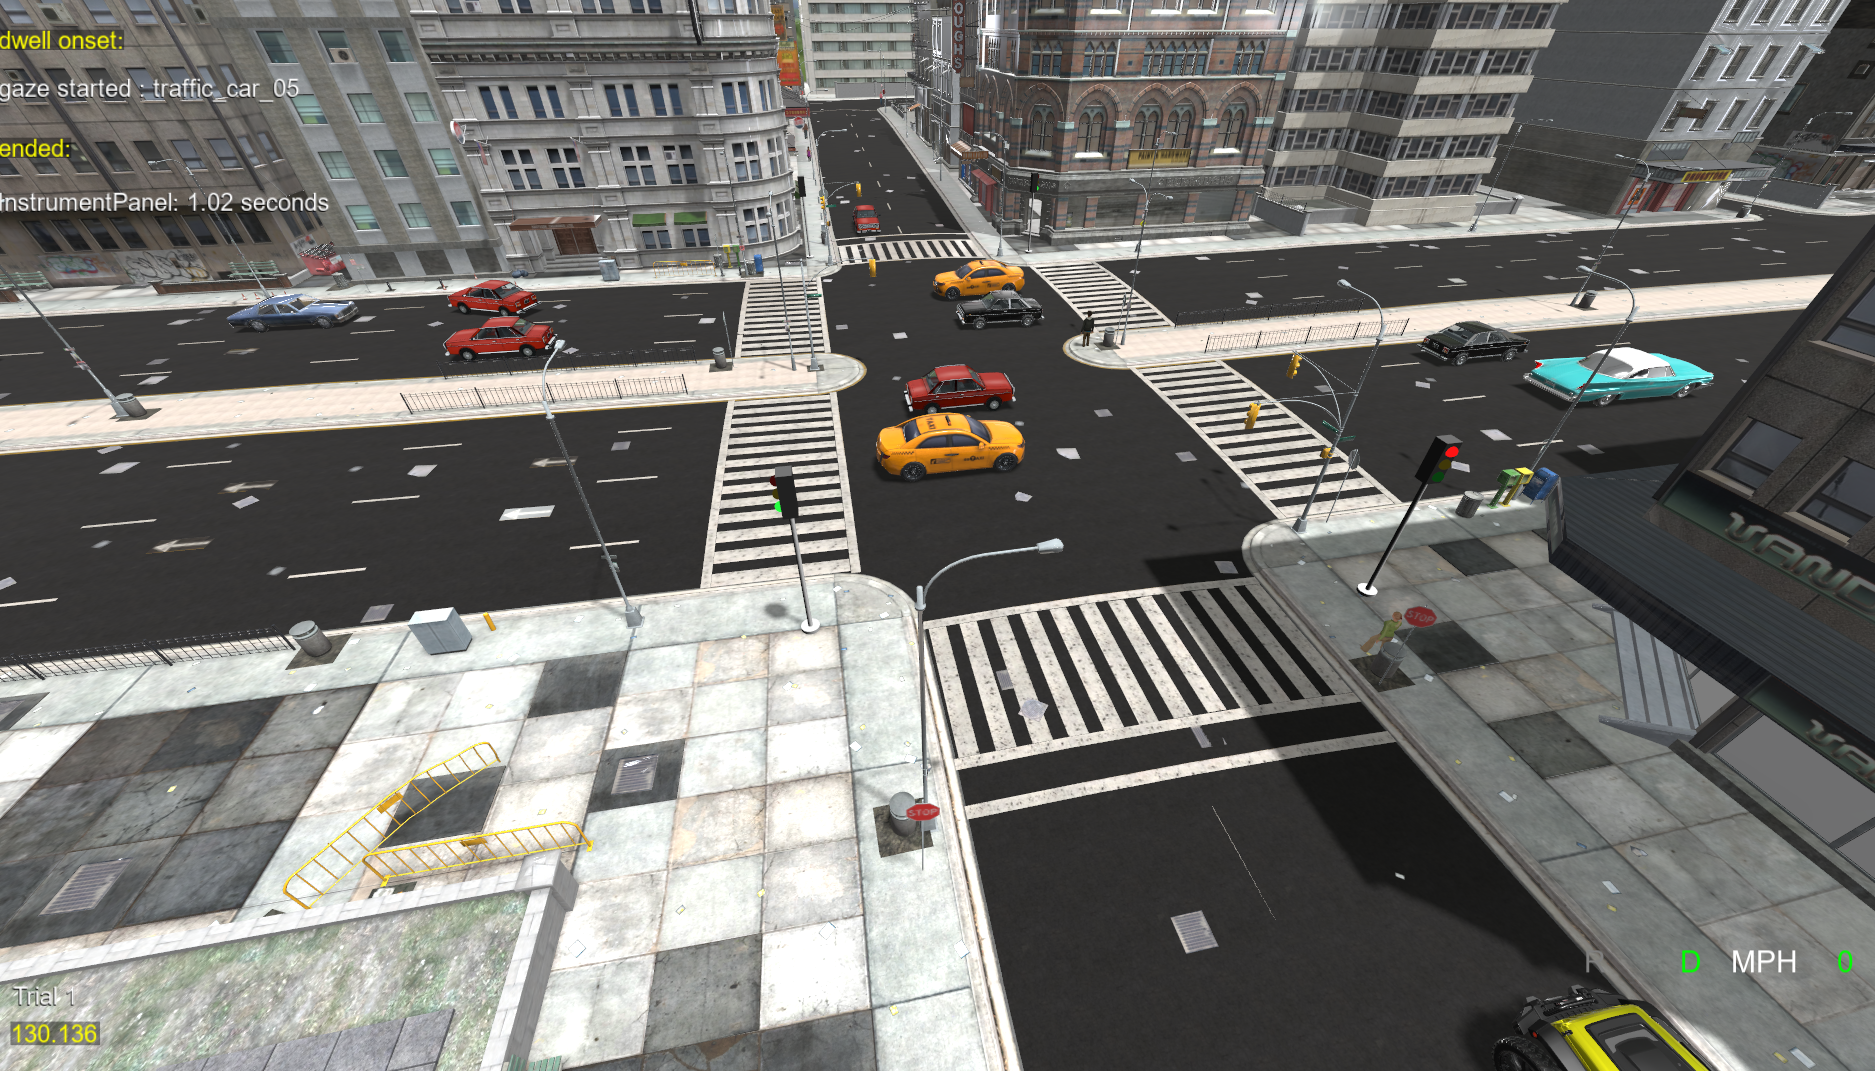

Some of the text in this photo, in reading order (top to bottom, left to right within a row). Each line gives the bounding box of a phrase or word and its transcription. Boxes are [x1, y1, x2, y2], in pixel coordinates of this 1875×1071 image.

[953, 0, 964, 69] OUGHS
[1405, 609, 1435, 624] STOP
[907, 807, 939, 818] STOP
